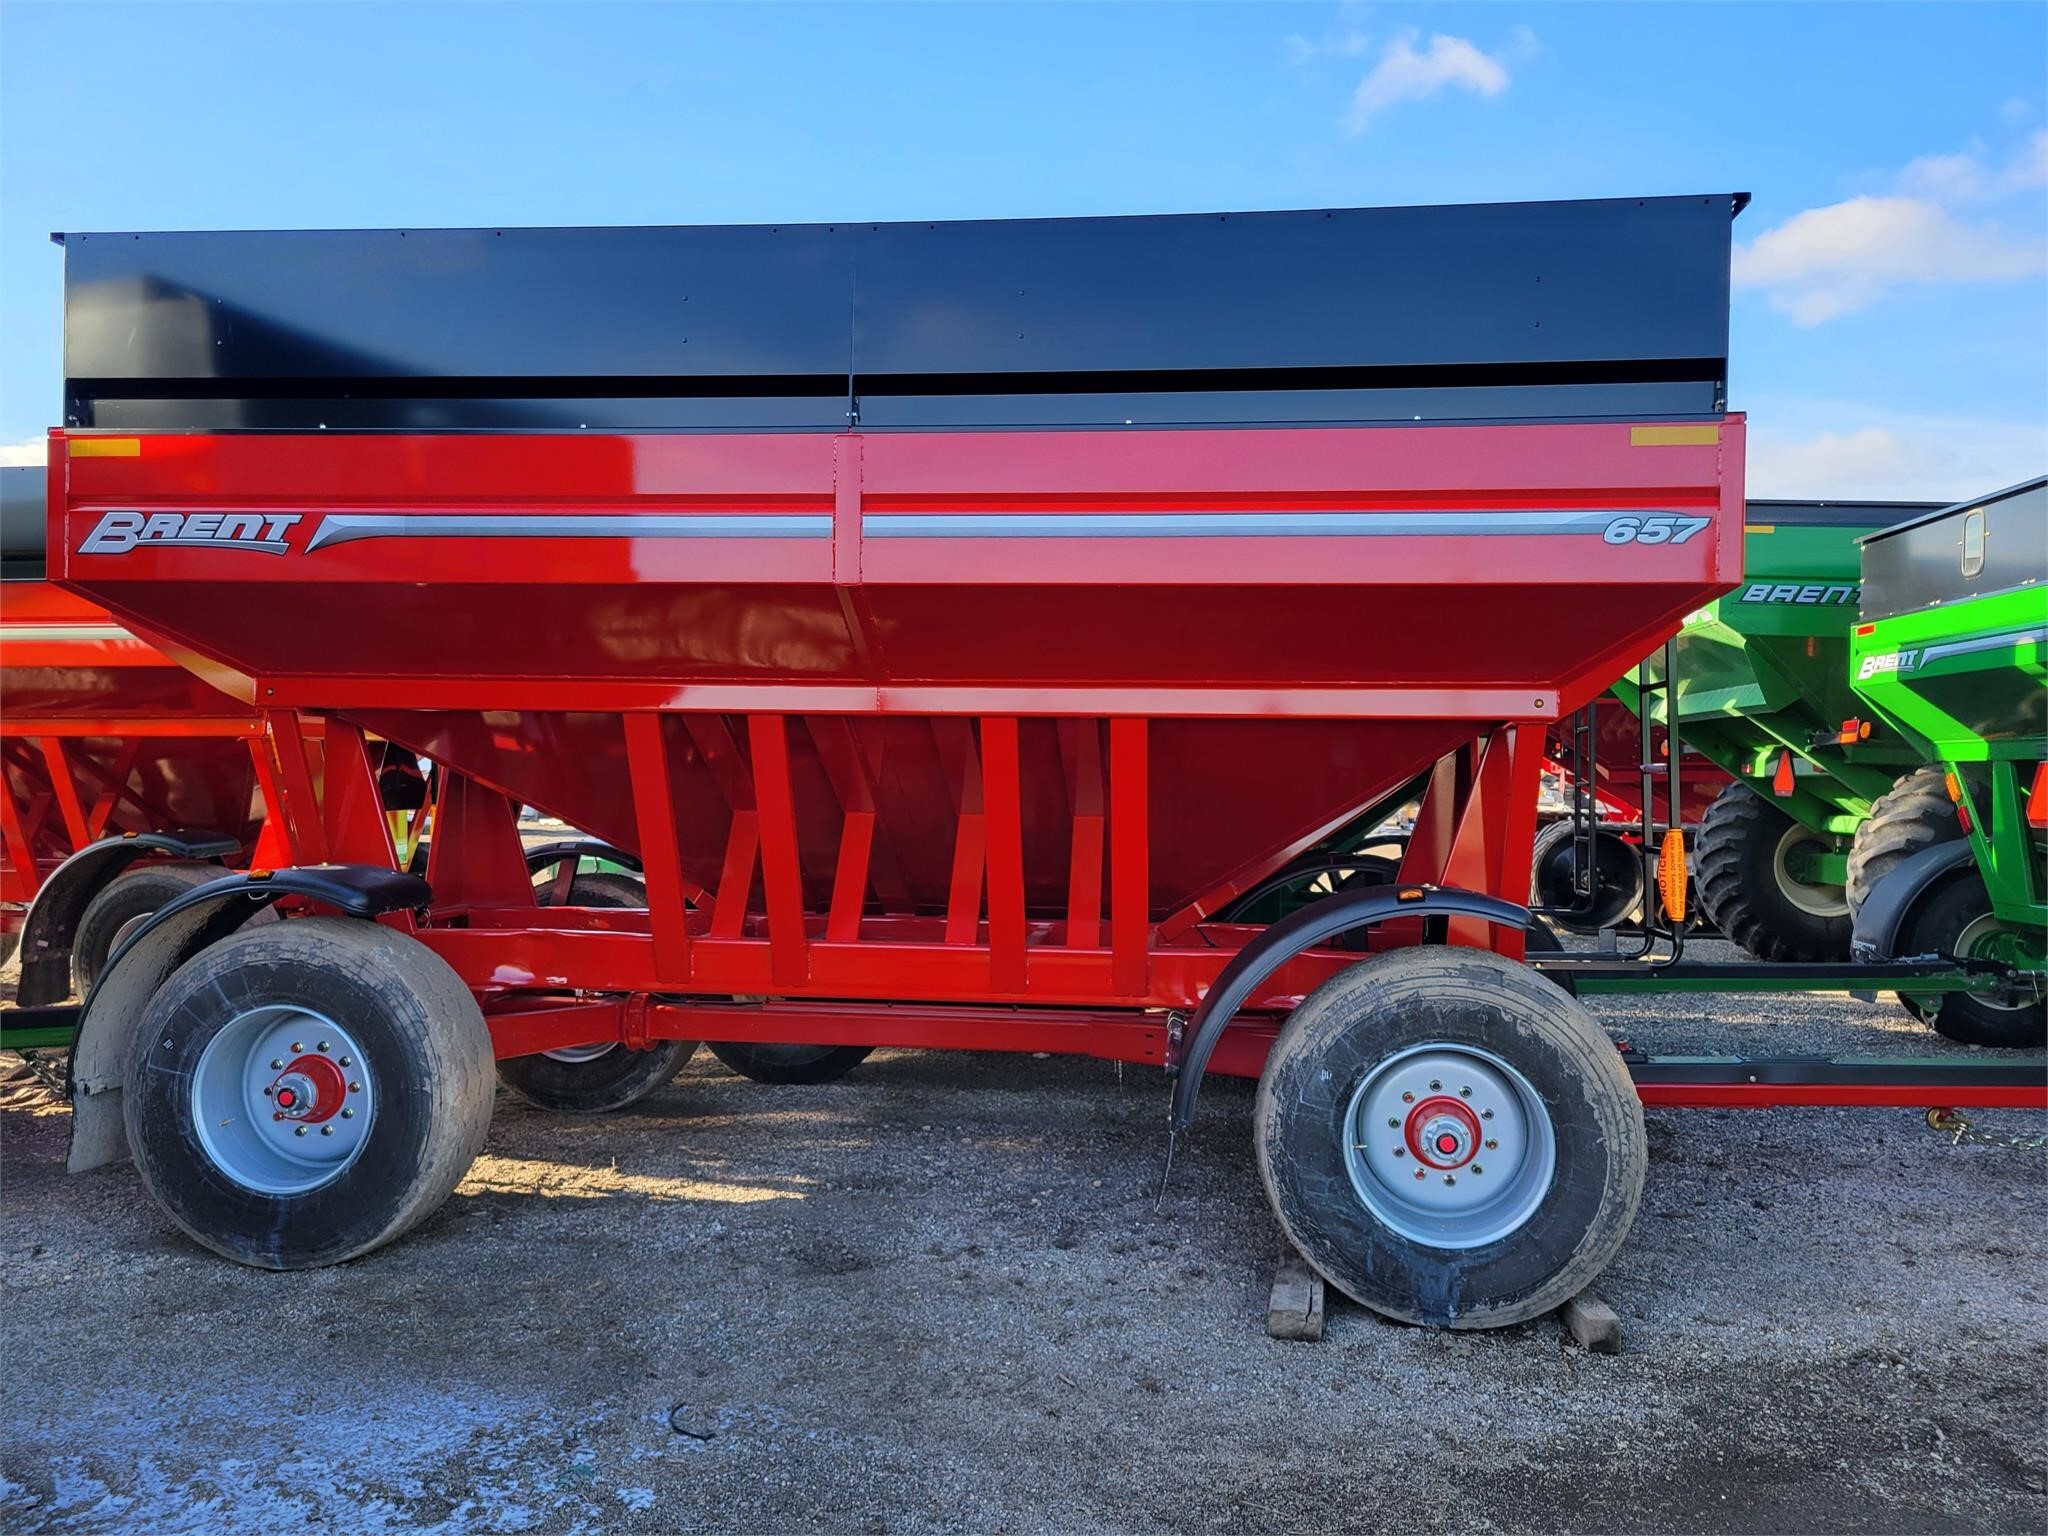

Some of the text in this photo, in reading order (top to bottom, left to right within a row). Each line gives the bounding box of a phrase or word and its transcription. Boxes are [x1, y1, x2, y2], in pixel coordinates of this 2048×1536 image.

[77, 512, 303, 555] BRENT
[1603, 517, 1712, 545] 657
[1857, 650, 1919, 680] BRENT
[1659, 851, 1667, 897] NOTICE
